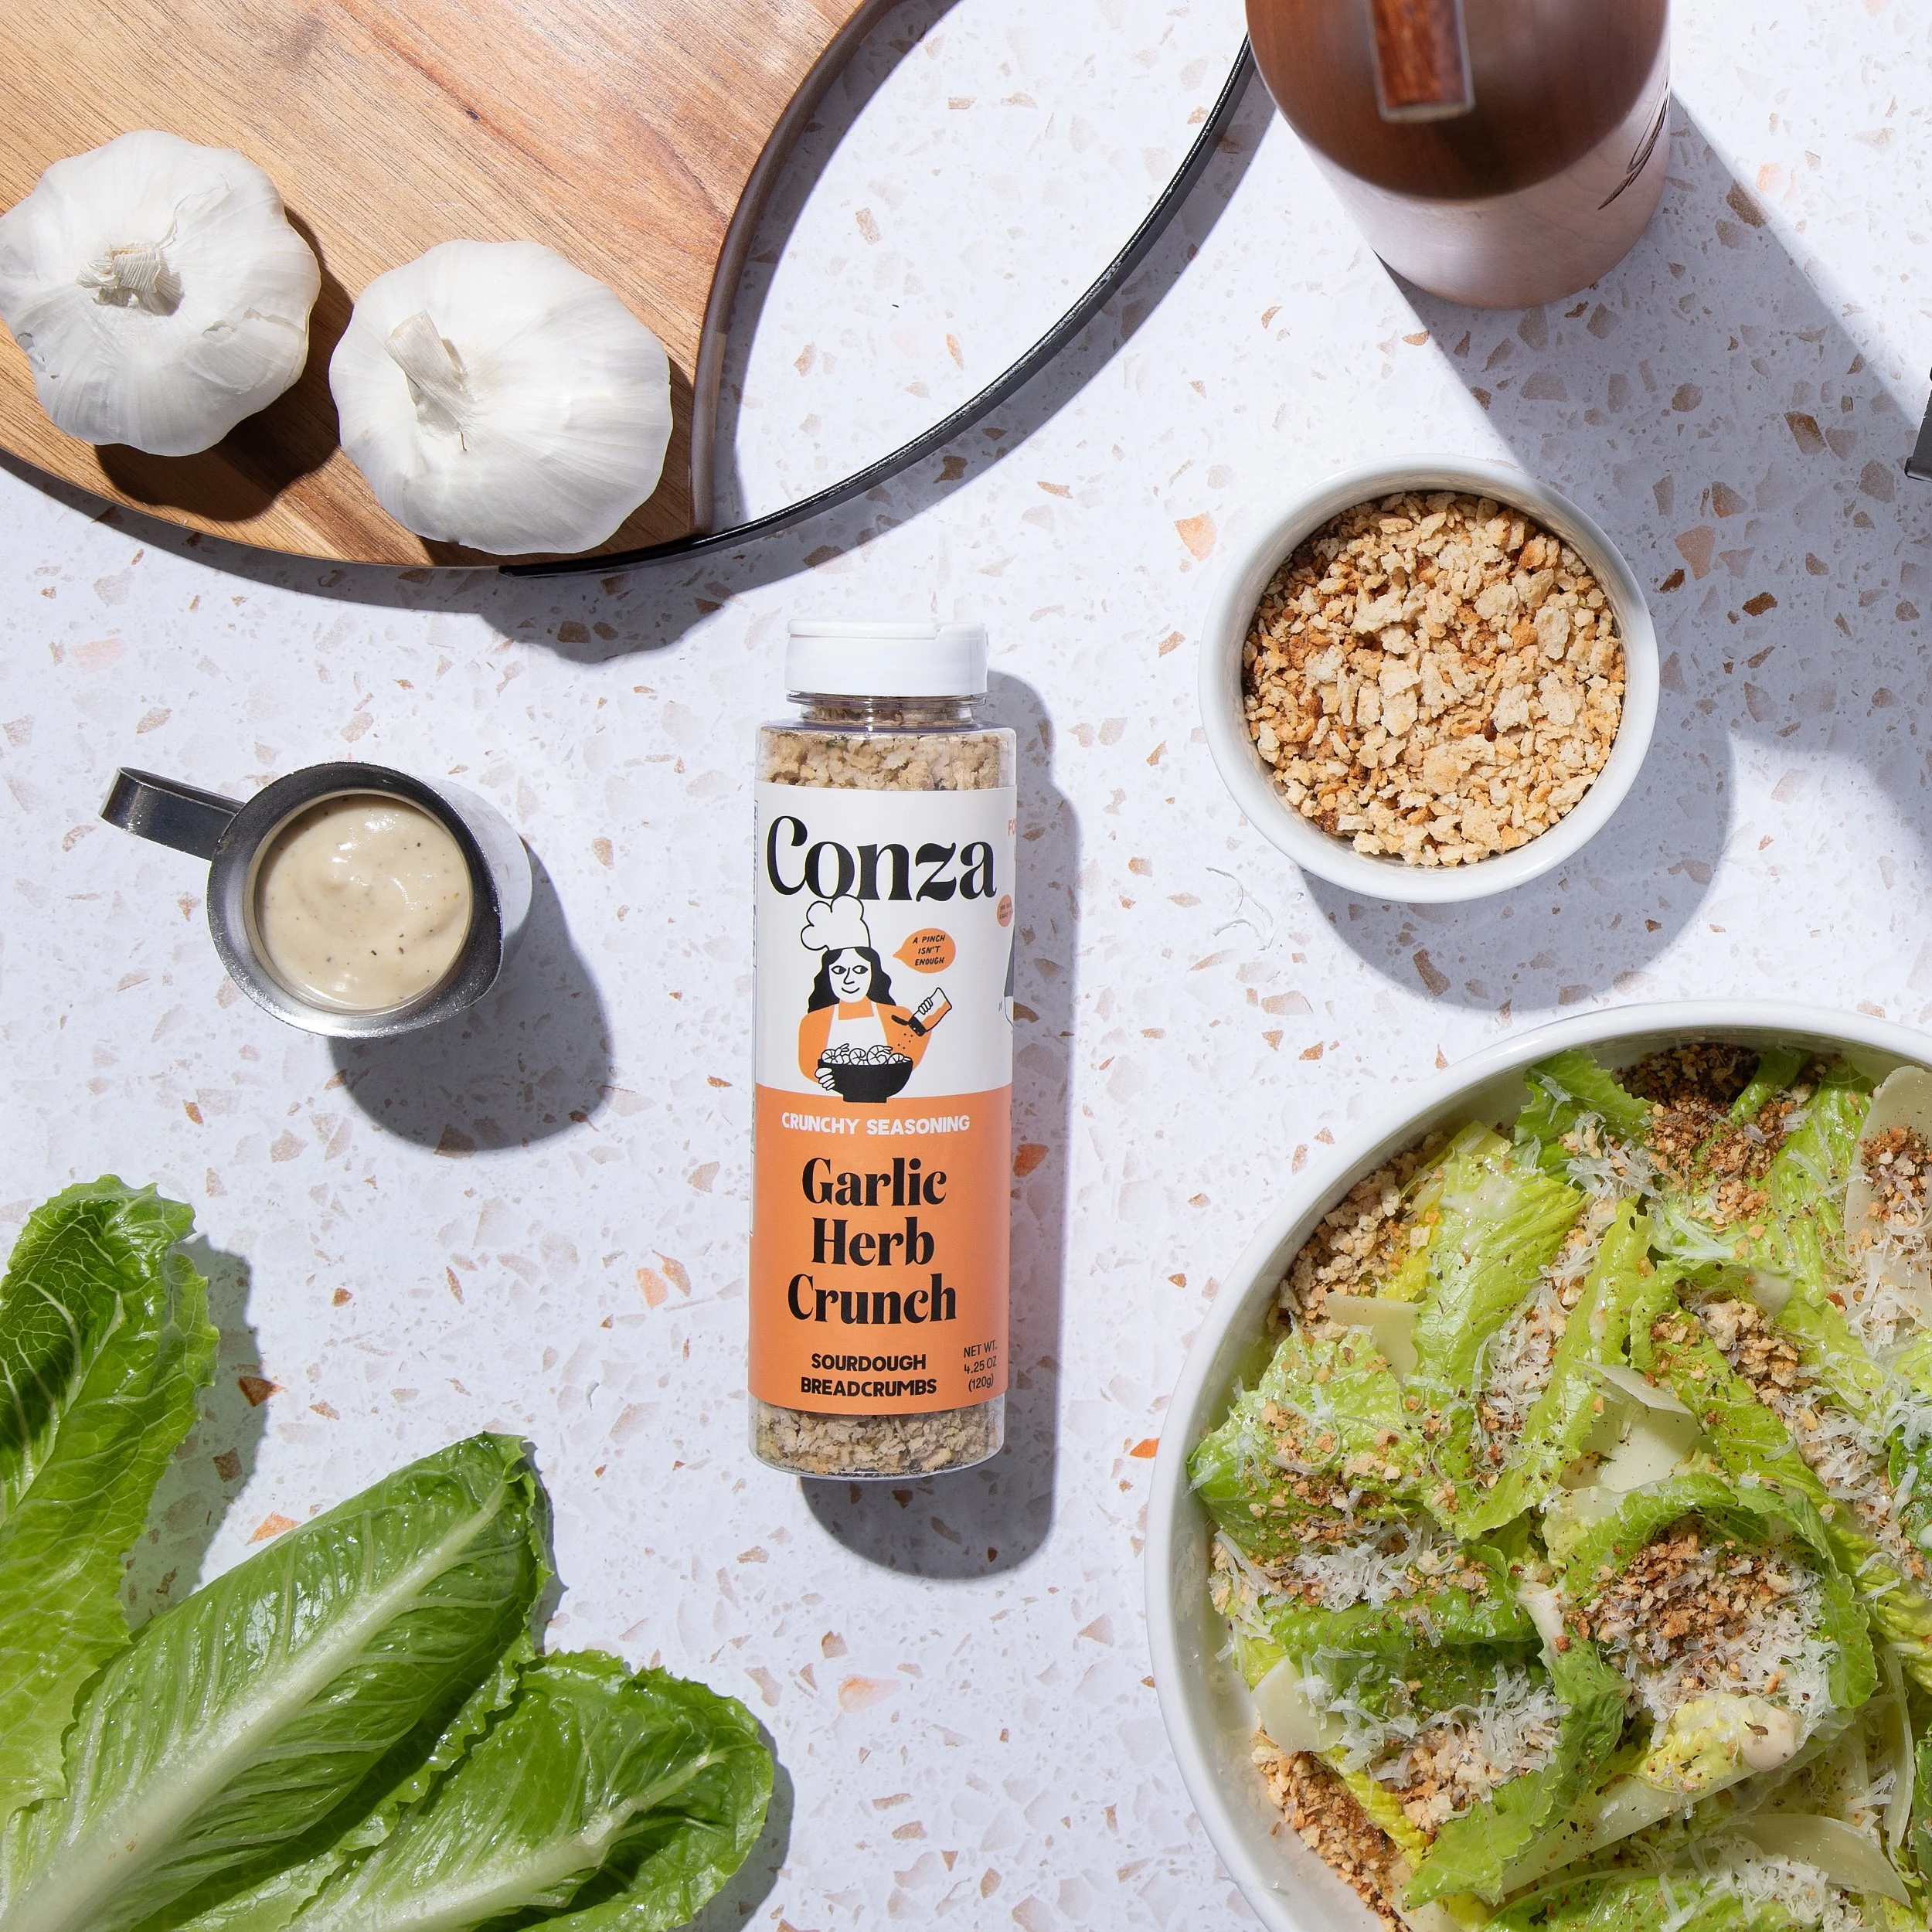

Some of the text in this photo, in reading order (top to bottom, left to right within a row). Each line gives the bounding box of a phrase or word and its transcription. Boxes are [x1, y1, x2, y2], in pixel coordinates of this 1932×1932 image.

[767, 815, 997, 902] Conza
[922, 934, 945, 943] PINCH
[918, 945, 940, 954] ISN'T
[915, 957, 944, 966] ENOUGH
[782, 1112, 970, 1135] CRUNCHY SEASONING
[802, 1157, 947, 1206] Garlic
[811, 1216, 934, 1266] Herb
[787, 1273, 957, 1325] Crunch
[964, 1340, 998, 1358] NET WT.
[811, 1353, 927, 1372] SOURDOUGH
[964, 1355, 997, 1374] 4.25 OZ
[801, 1376, 937, 1397] BREADCRUMBS
[968, 1373, 994, 1393] (120g)
